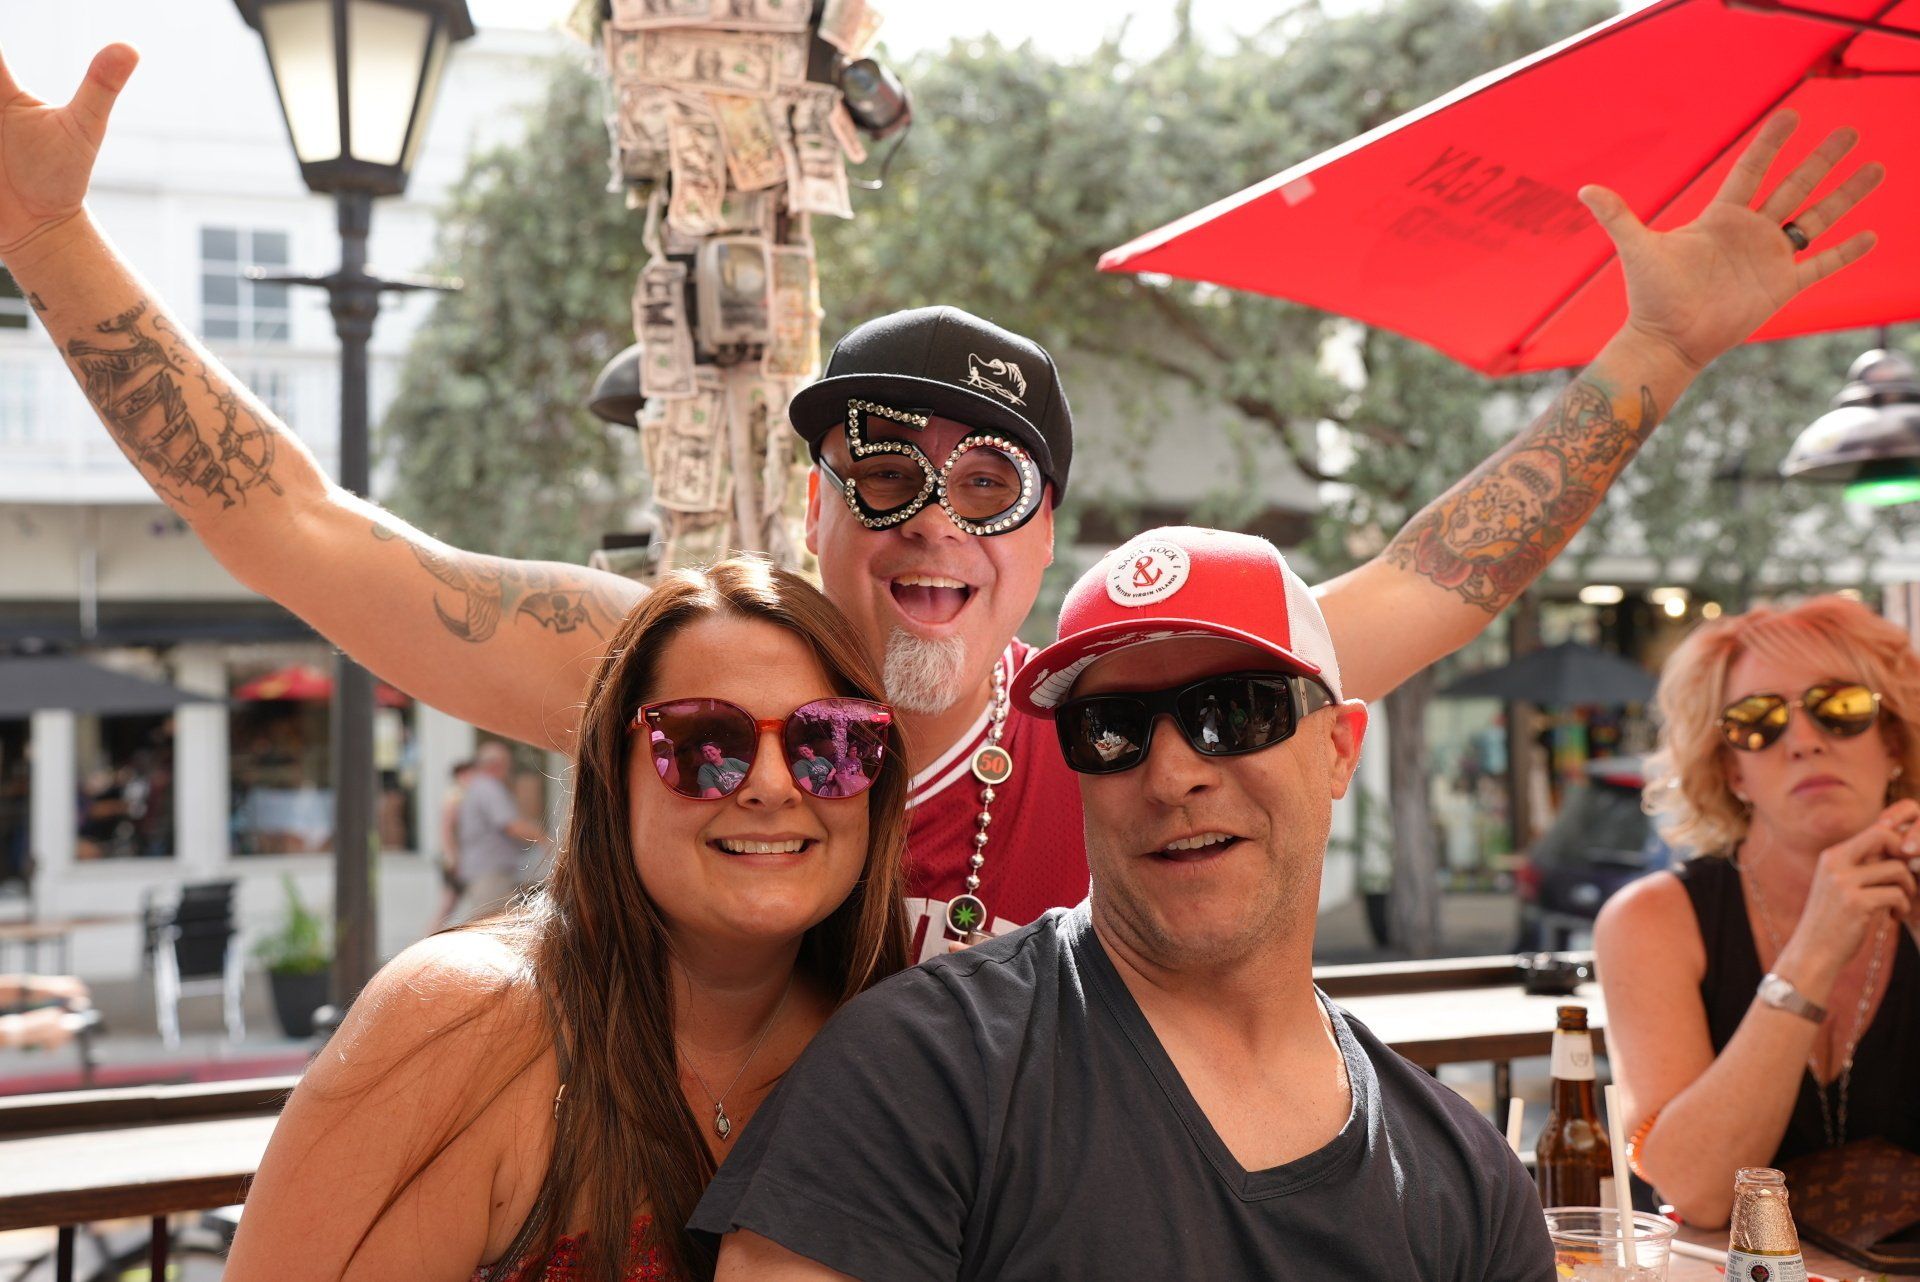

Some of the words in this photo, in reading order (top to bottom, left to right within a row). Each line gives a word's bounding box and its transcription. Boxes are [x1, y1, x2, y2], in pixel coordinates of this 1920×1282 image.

[1149, 546, 1179, 561] ROCK
[1115, 584, 1131, 597] BRITISH
[1155, 574, 1178, 593] ISLANDS
[979, 754, 1005, 774] 50
